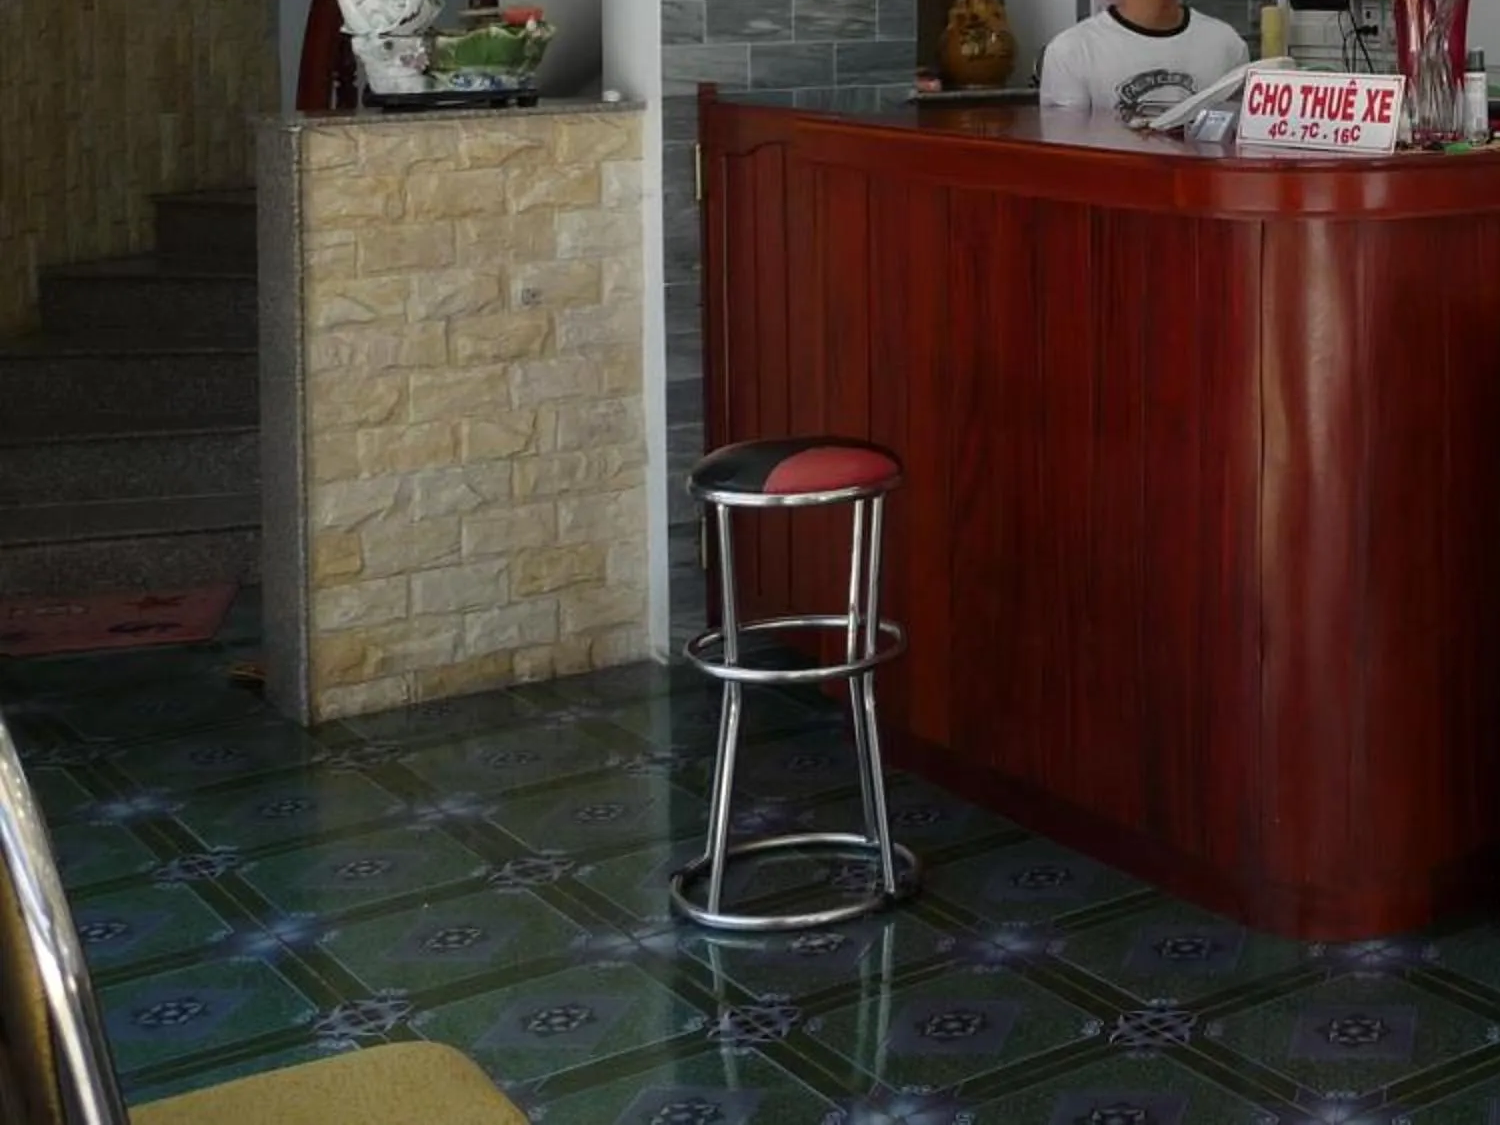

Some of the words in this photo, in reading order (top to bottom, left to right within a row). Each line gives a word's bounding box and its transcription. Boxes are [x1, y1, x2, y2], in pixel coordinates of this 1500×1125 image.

[1248, 82, 1293, 117] CHO
[1299, 80, 1359, 122] THUÊ
[1361, 88, 1395, 124] XE
